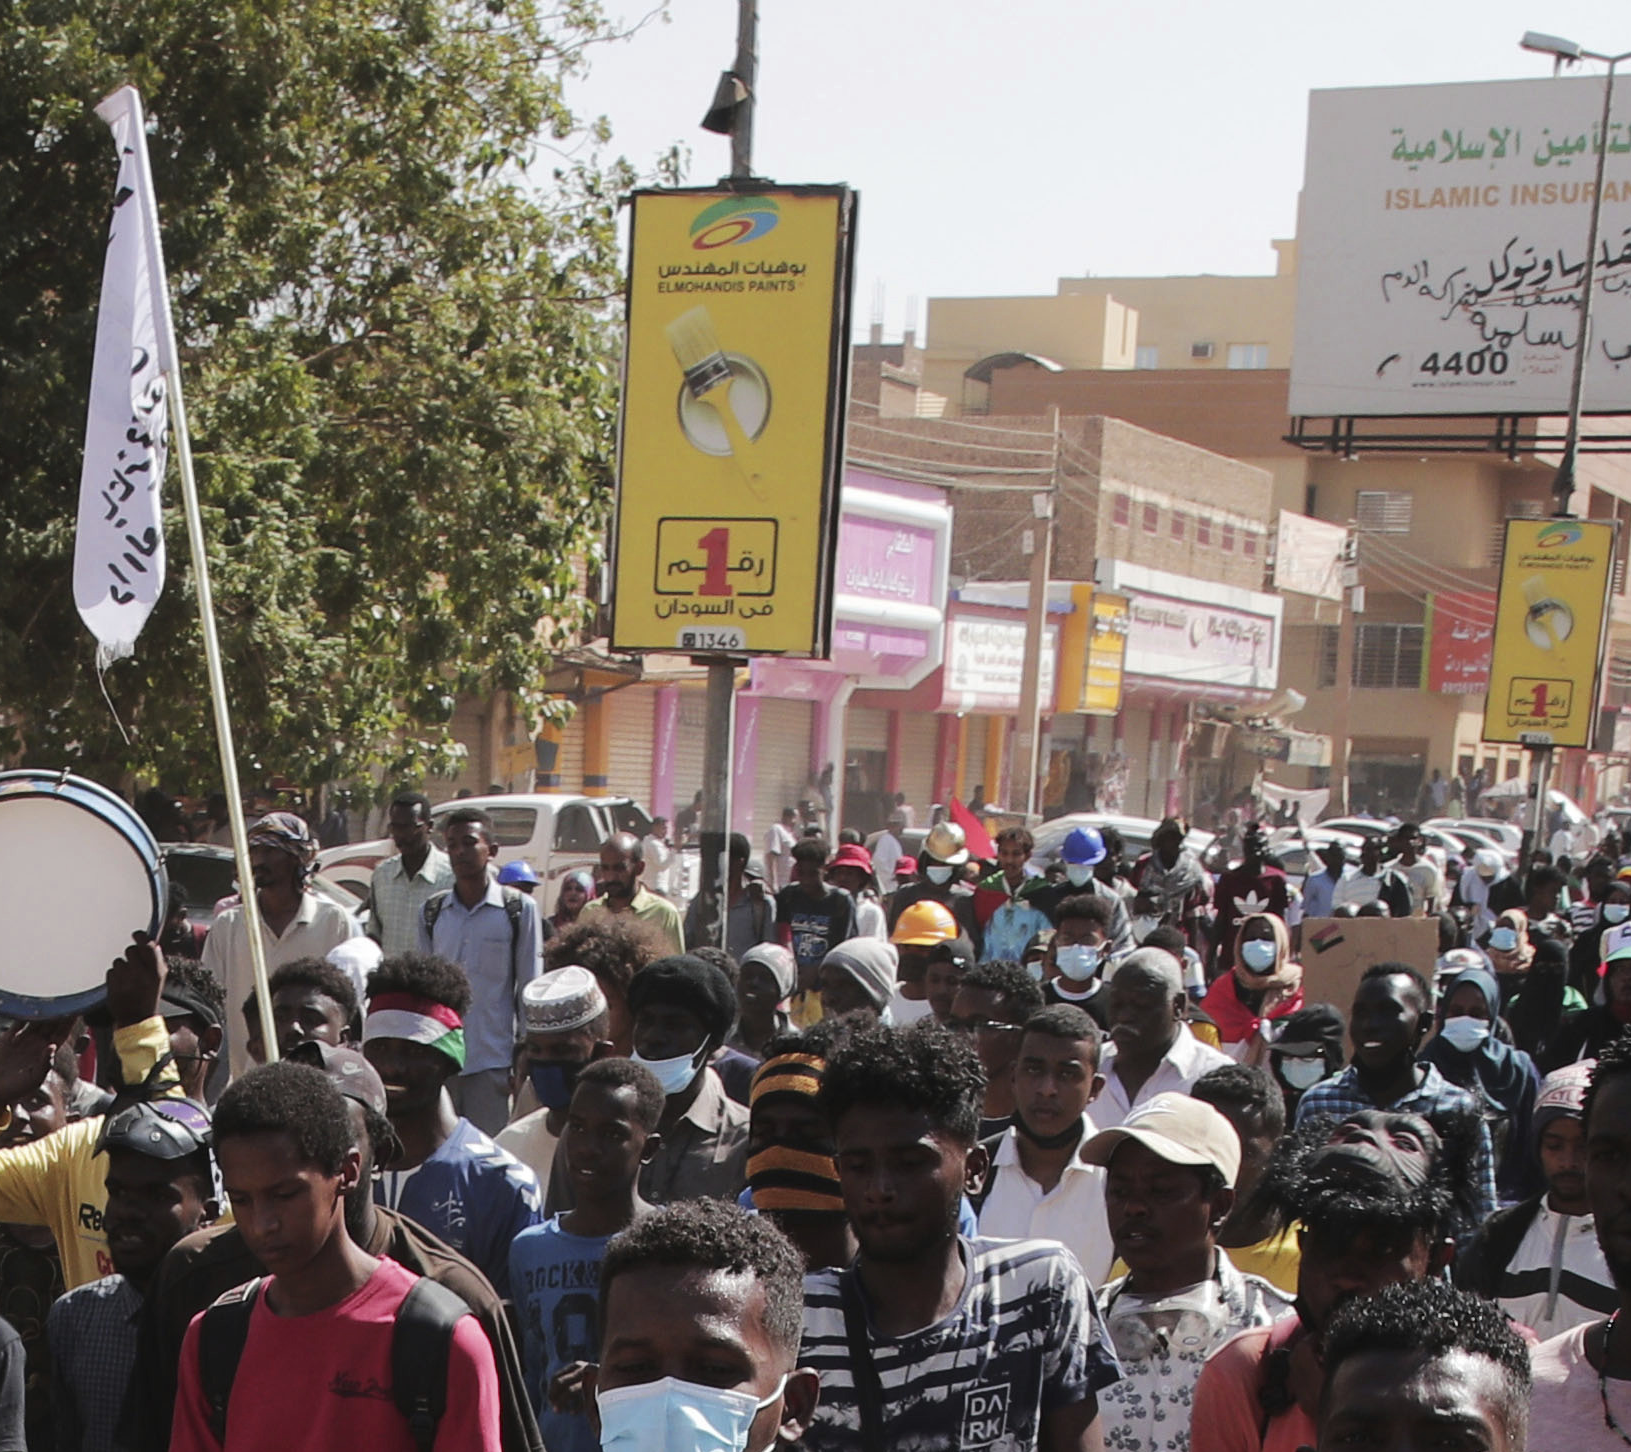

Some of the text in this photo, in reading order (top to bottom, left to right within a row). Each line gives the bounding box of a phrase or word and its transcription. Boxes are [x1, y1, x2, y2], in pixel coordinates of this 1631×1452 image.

[1390, 124, 1521, 172] الإسلامية
[1386, 184, 1500, 210] ISLAMIC
[658, 261, 807, 279] بوهيات المهندس
[657, 279, 796, 294] ELMOHANDIS PAINTS
[1420, 351, 1508, 376] 4400
[697, 526, 734, 597] 1
[655, 600, 734, 620] السودان
[698, 632, 740, 649] 1346
[1530, 683, 1549, 718] 1
